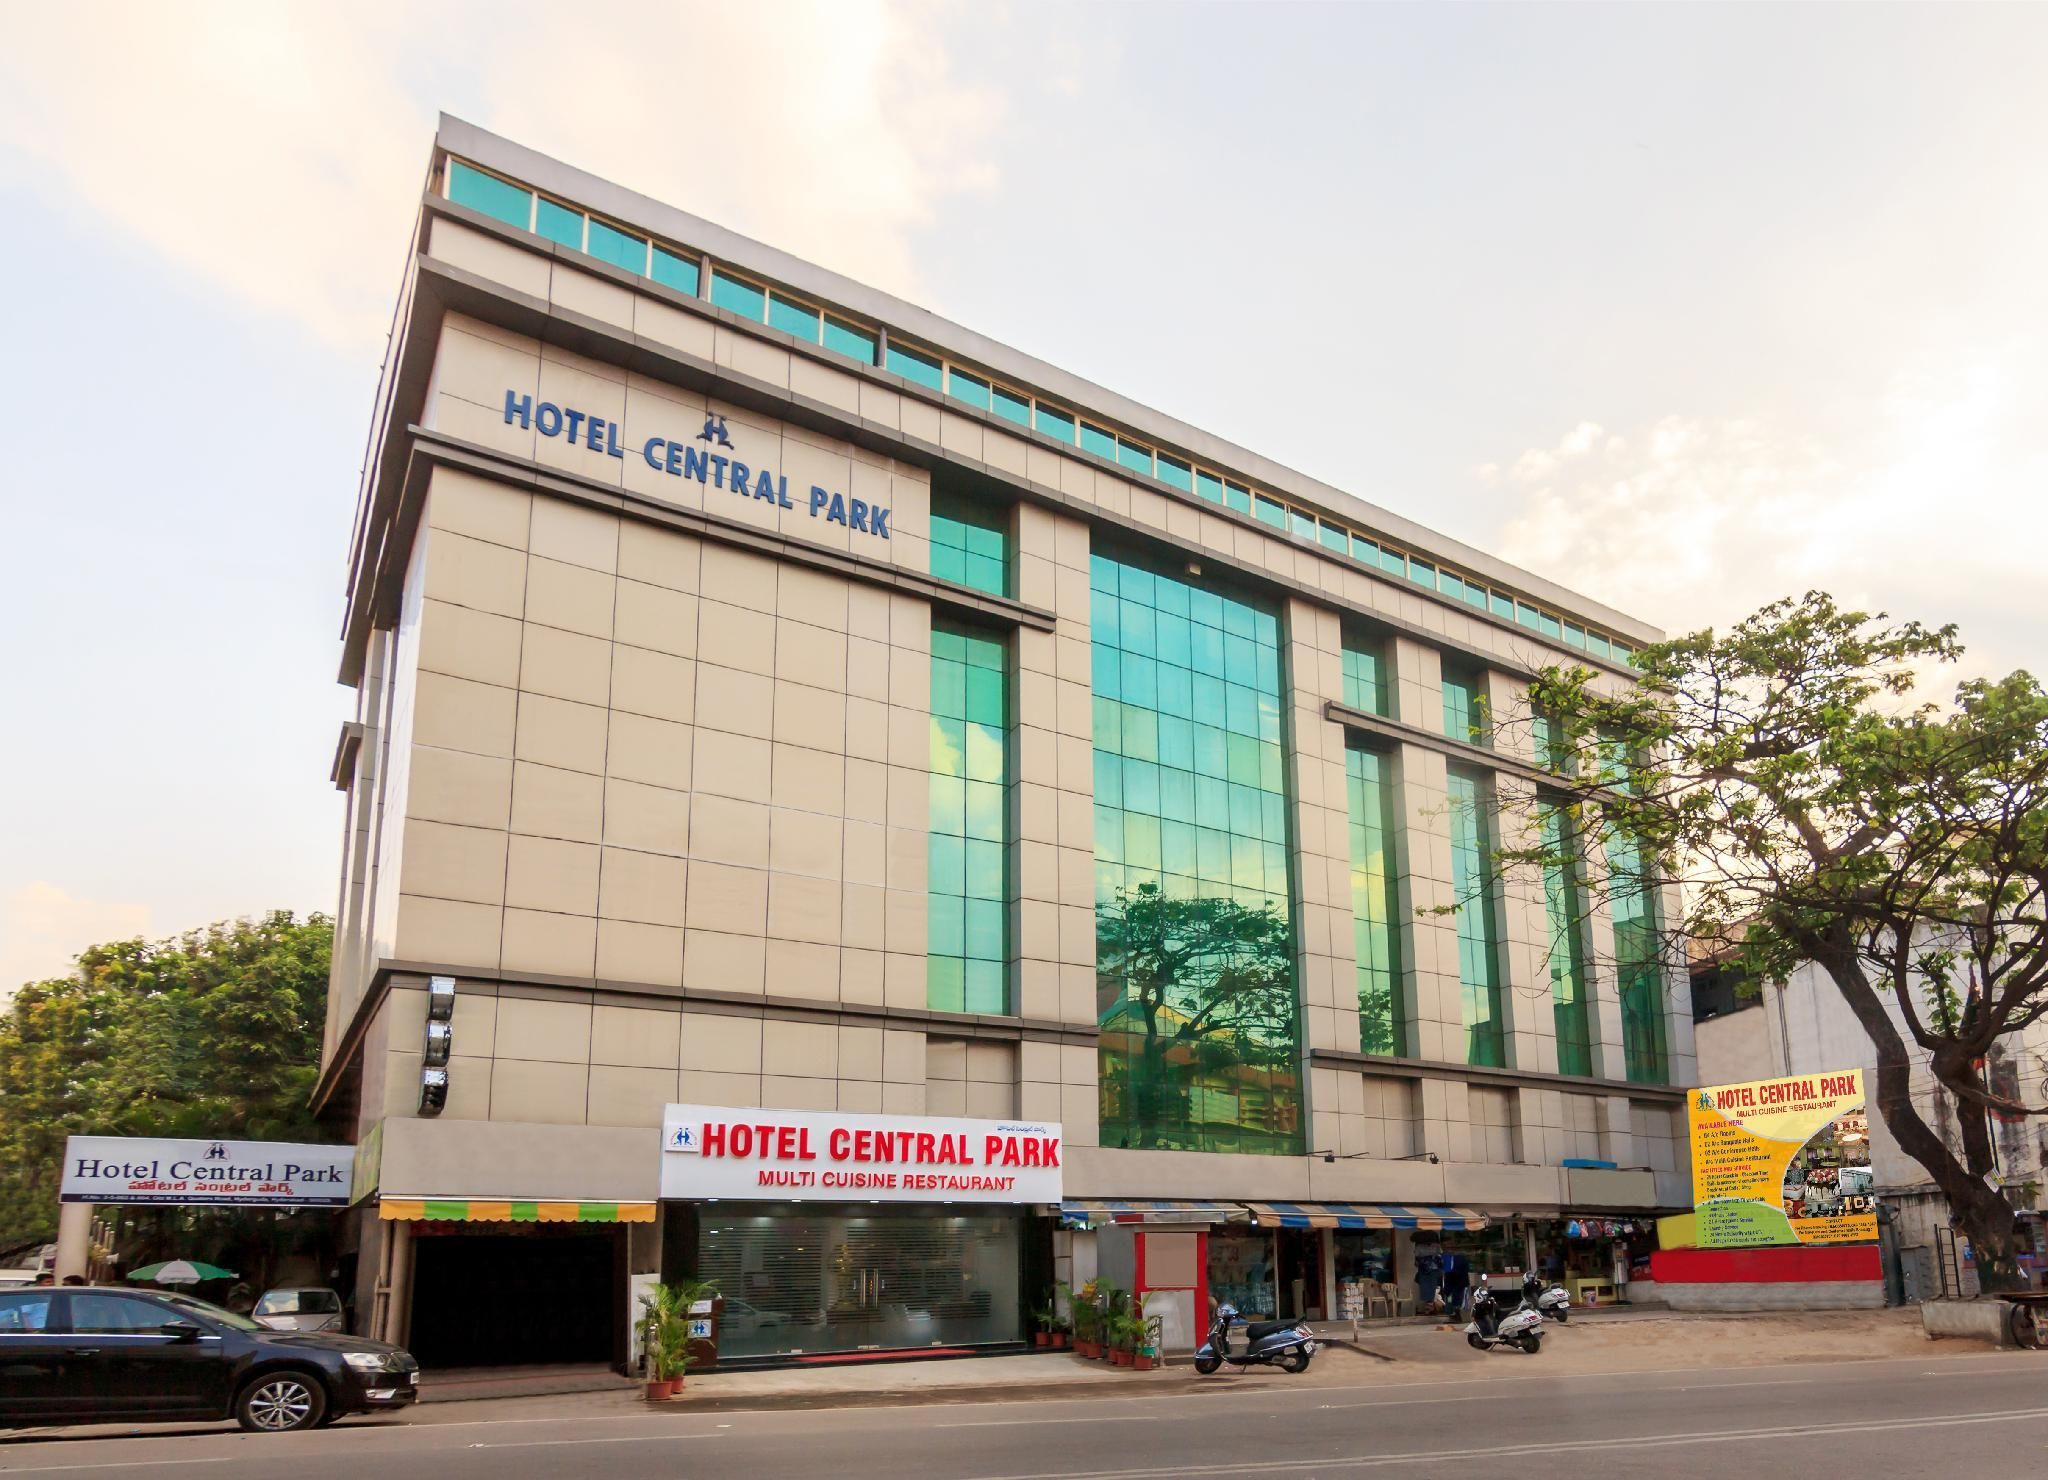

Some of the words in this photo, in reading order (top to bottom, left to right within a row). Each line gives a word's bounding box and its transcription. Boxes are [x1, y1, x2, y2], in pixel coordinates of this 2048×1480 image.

[503, 389, 624, 459] HOTEL
[643, 437, 794, 510] CENTRAL
[809, 485, 892, 540] PARK
[1717, 1087, 1756, 1110] HOTEL
[1759, 1080, 1818, 1104] CENTRAL
[1820, 1074, 1857, 1097] PARK
[1736, 1109, 1757, 1118] MULTI
[1758, 1106, 1788, 1115] CUISINE
[1789, 1100, 1837, 1112] RESTAURANT
[1728, 1119, 1744, 1127] HERE
[702, 1123, 816, 1160] HOTEL
[830, 1128, 974, 1165] CENTRAL
[985, 1135, 1061, 1168] PARK
[74, 1159, 159, 1179] Hotel
[169, 1160, 273, 1181] Central
[283, 1163, 344, 1183] Park
[758, 1170, 816, 1187] MULTI
[822, 1171, 897, 1188] CUISINE
[903, 1173, 1016, 1191] RESTAURANT
